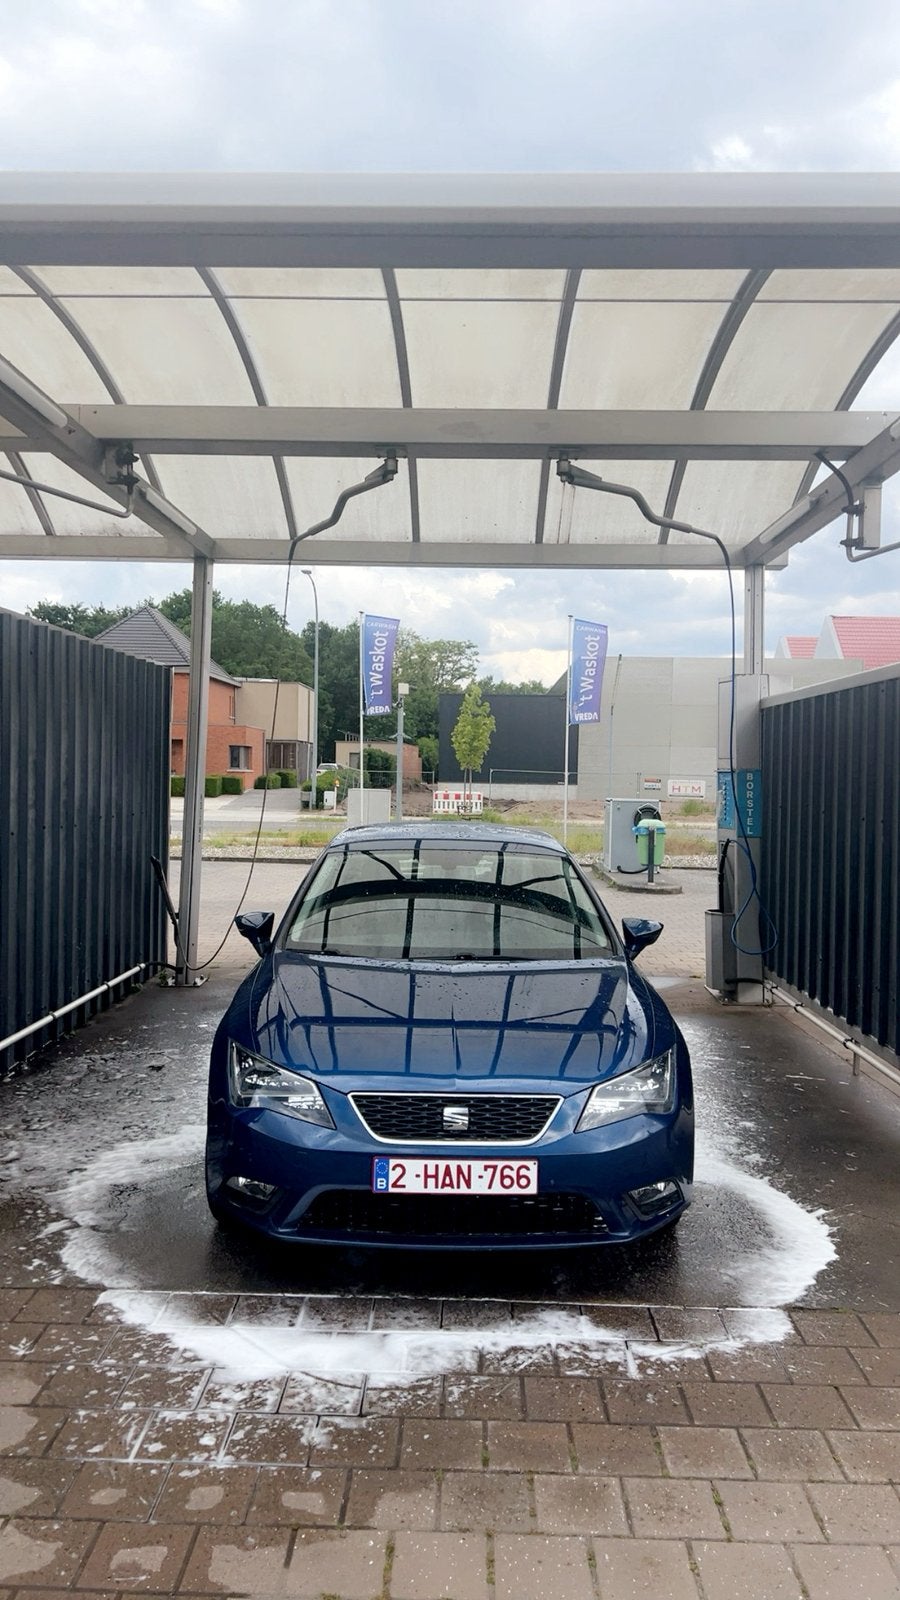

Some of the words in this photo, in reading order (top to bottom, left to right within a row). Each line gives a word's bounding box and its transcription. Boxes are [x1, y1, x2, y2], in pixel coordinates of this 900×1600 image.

[369, 630, 389, 688] Waskot
[580, 634, 600, 693] Waskot
[671, 784, 702, 794] HTM
[746, 772, 754, 835] BORSTEL
[376, 1177, 387, 1190] B
[391, 1163, 531, 1190] 2-HAN-766
